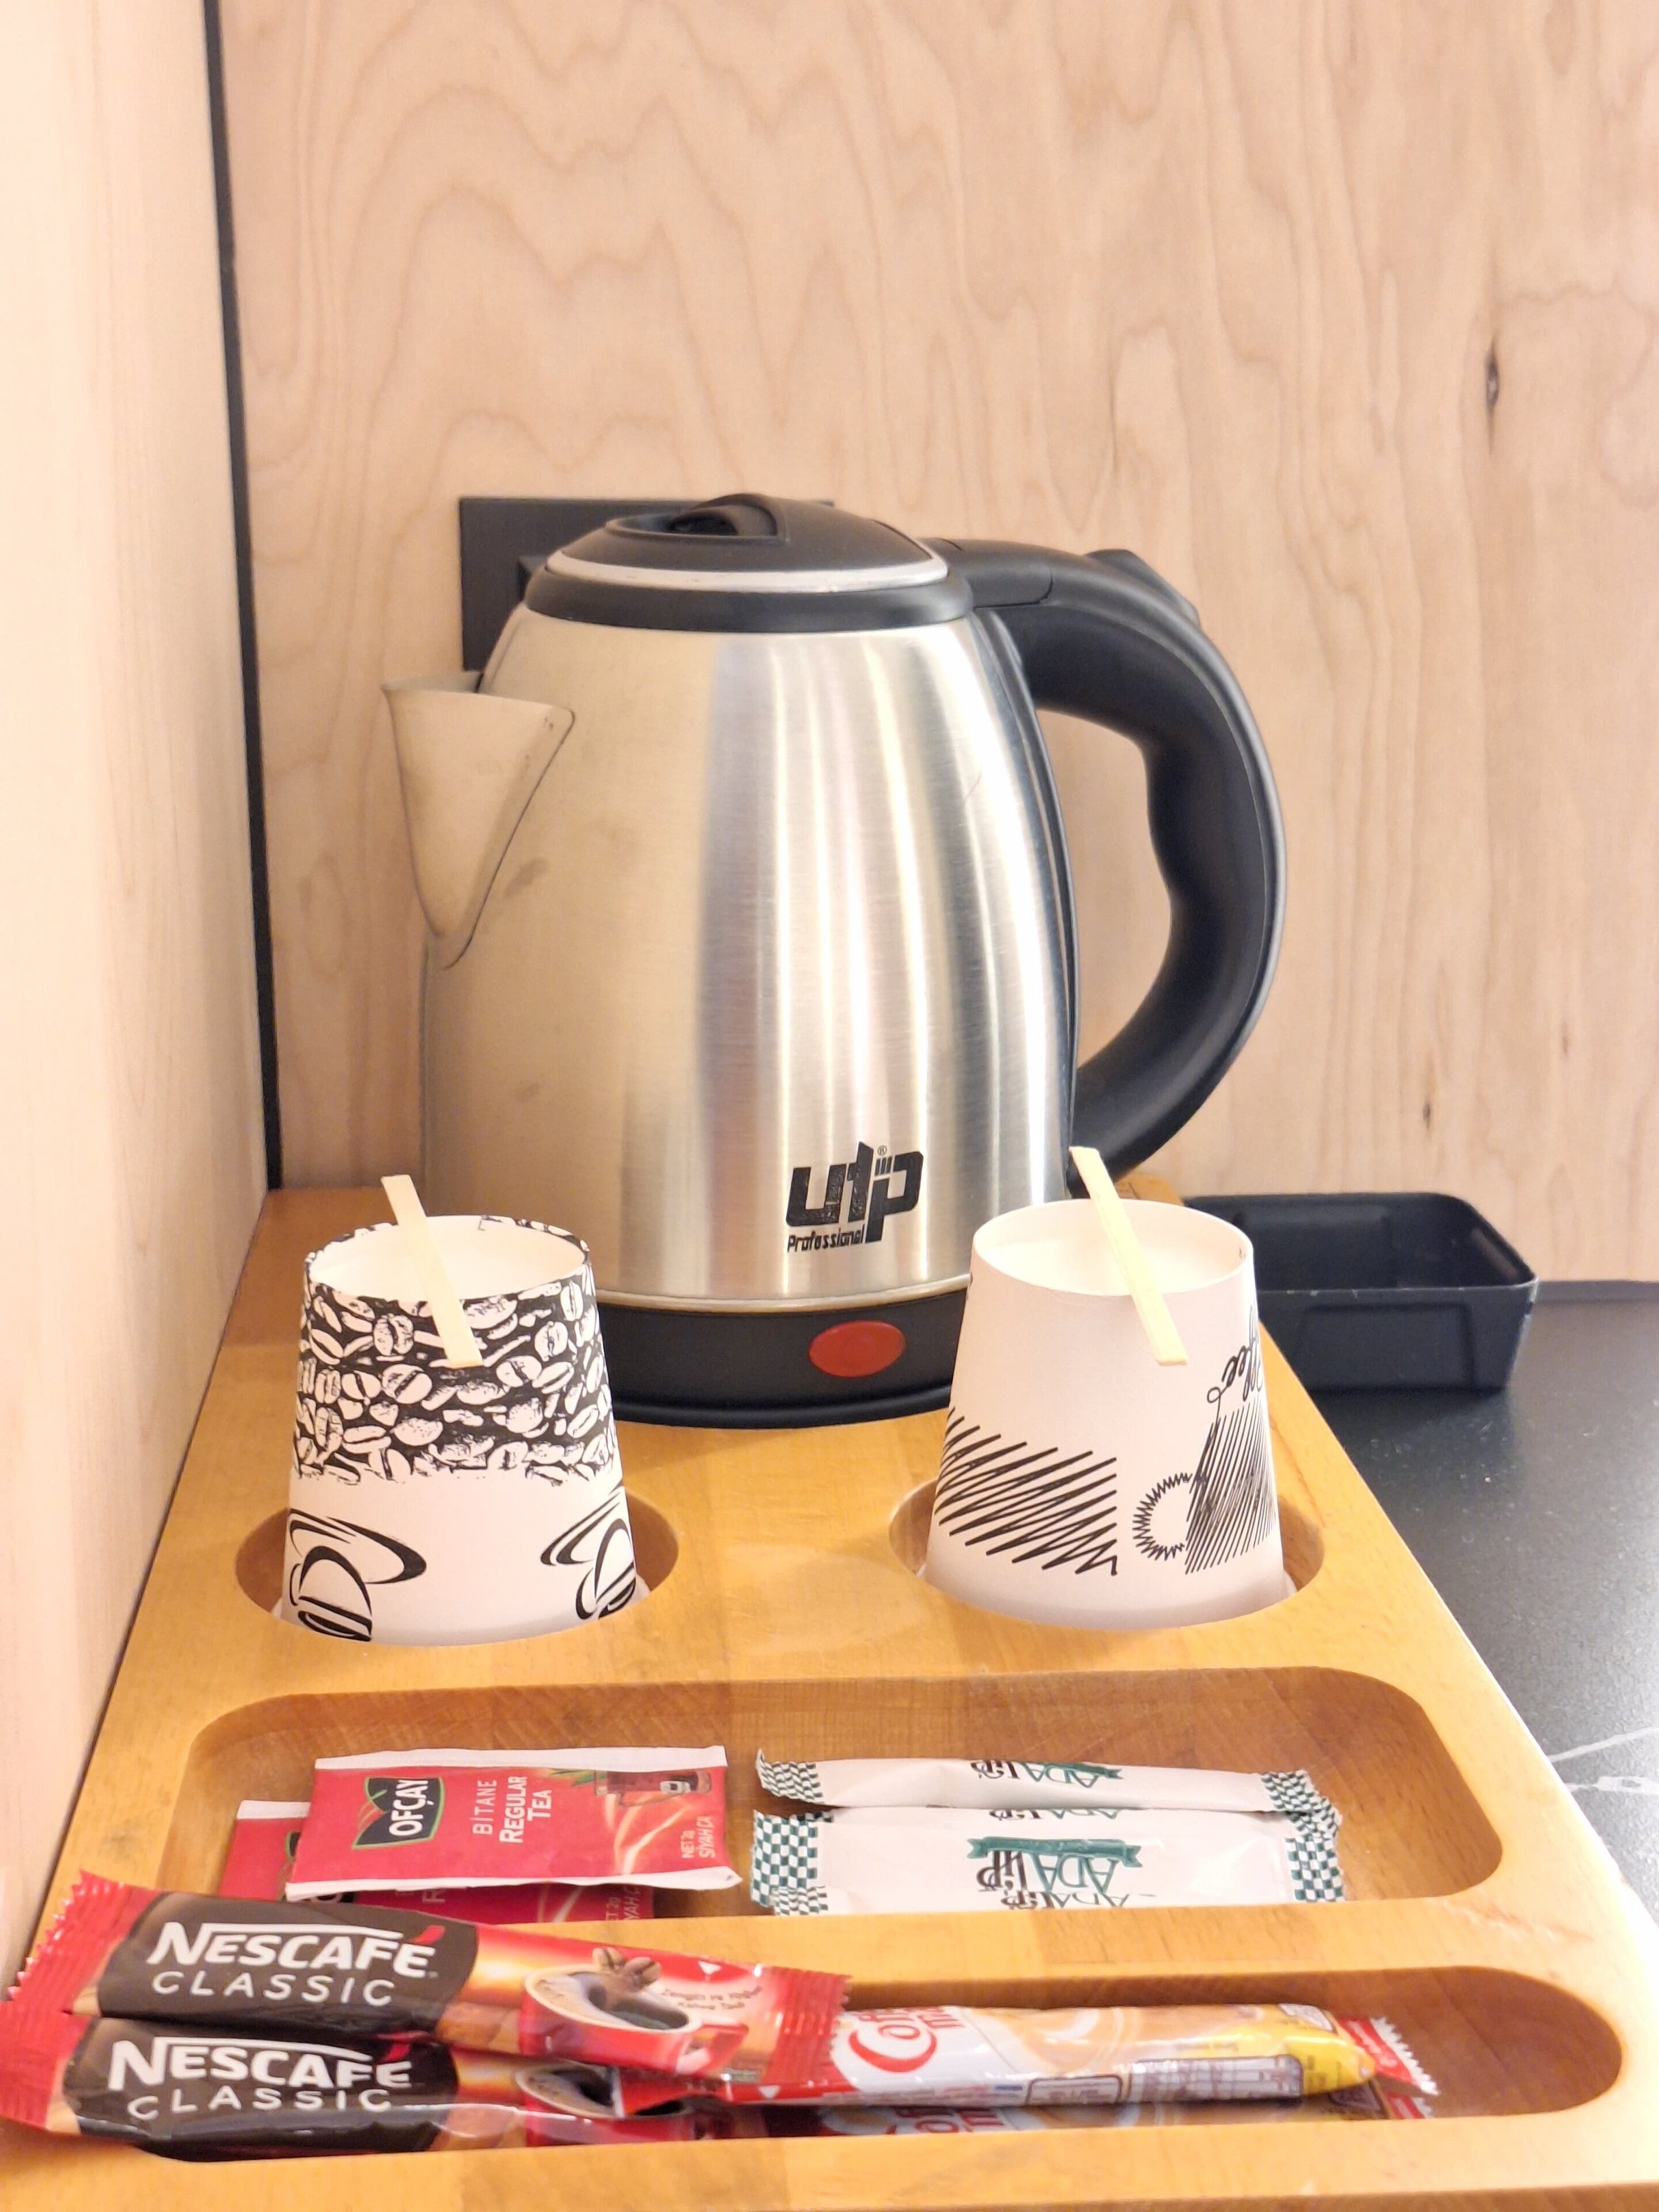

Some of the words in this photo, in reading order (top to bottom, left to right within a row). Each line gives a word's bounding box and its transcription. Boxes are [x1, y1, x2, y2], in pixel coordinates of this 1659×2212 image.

[787, 1224, 865, 1252] Professional
[389, 1779, 434, 1836] OFÇAY
[469, 1780, 497, 1835] BİTANE
[499, 1776, 528, 1843] REGULAR
[527, 1789, 552, 1822] TEA
[1031, 1850, 1120, 1894] ADA
[147, 1921, 446, 1978] NESCAFÉ
[151, 1971, 395, 2006] CLASSIC
[108, 2036, 412, 2091] NESCAFÉ
[127, 2086, 392, 2121] CLASSIC
